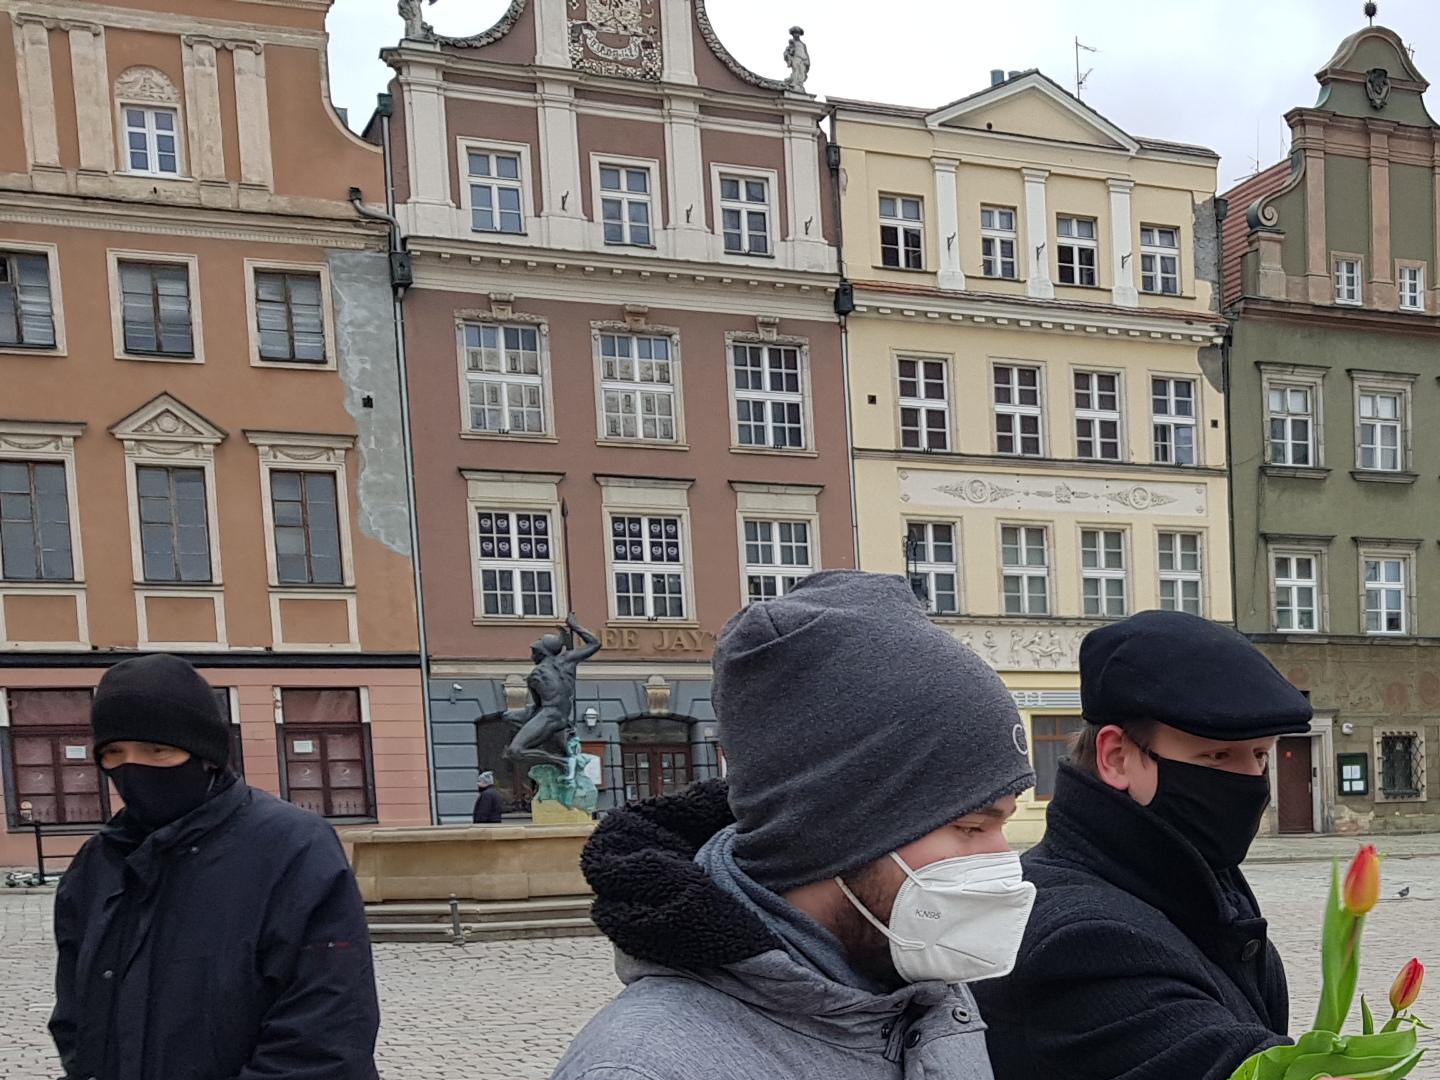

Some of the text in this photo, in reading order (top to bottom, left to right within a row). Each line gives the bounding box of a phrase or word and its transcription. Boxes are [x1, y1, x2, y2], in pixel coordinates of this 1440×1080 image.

[576, 628, 717, 652] EE JAY'
[915, 908, 942, 920] KN95
